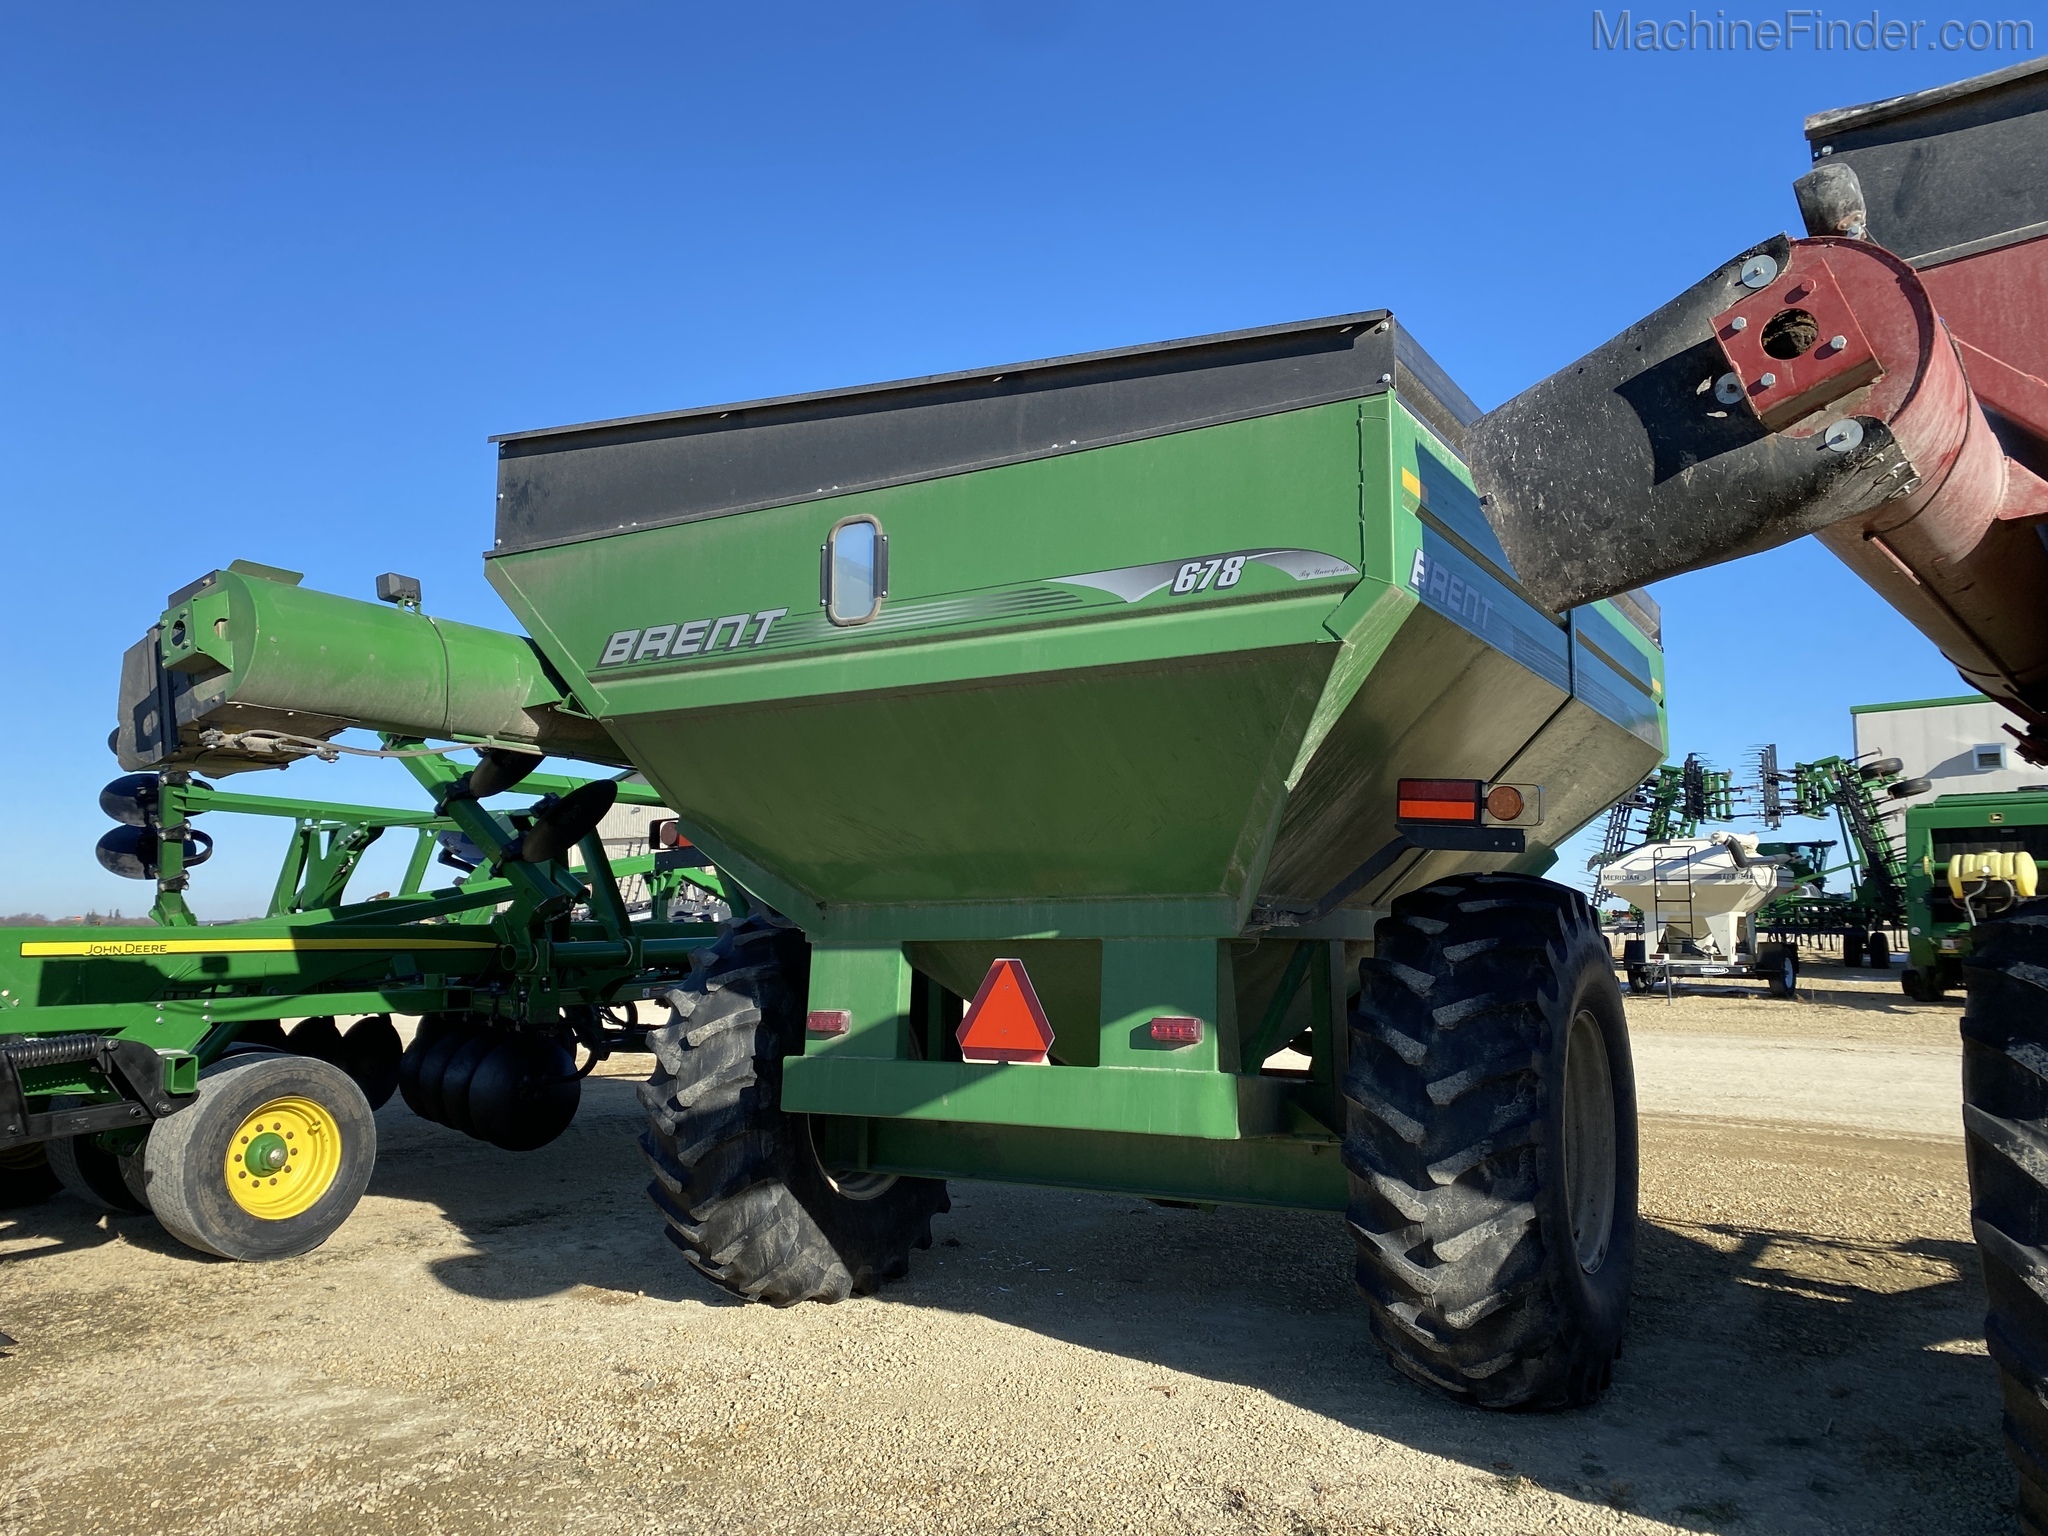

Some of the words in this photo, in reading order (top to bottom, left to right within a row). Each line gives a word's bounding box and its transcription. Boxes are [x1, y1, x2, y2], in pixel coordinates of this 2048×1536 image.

[1169, 556, 1247, 596] 678
[1409, 547, 1494, 630] BRENT
[596, 607, 789, 668] BRENT
[85, 944, 122, 954] JOHN
[125, 943, 167, 953] DEERE
